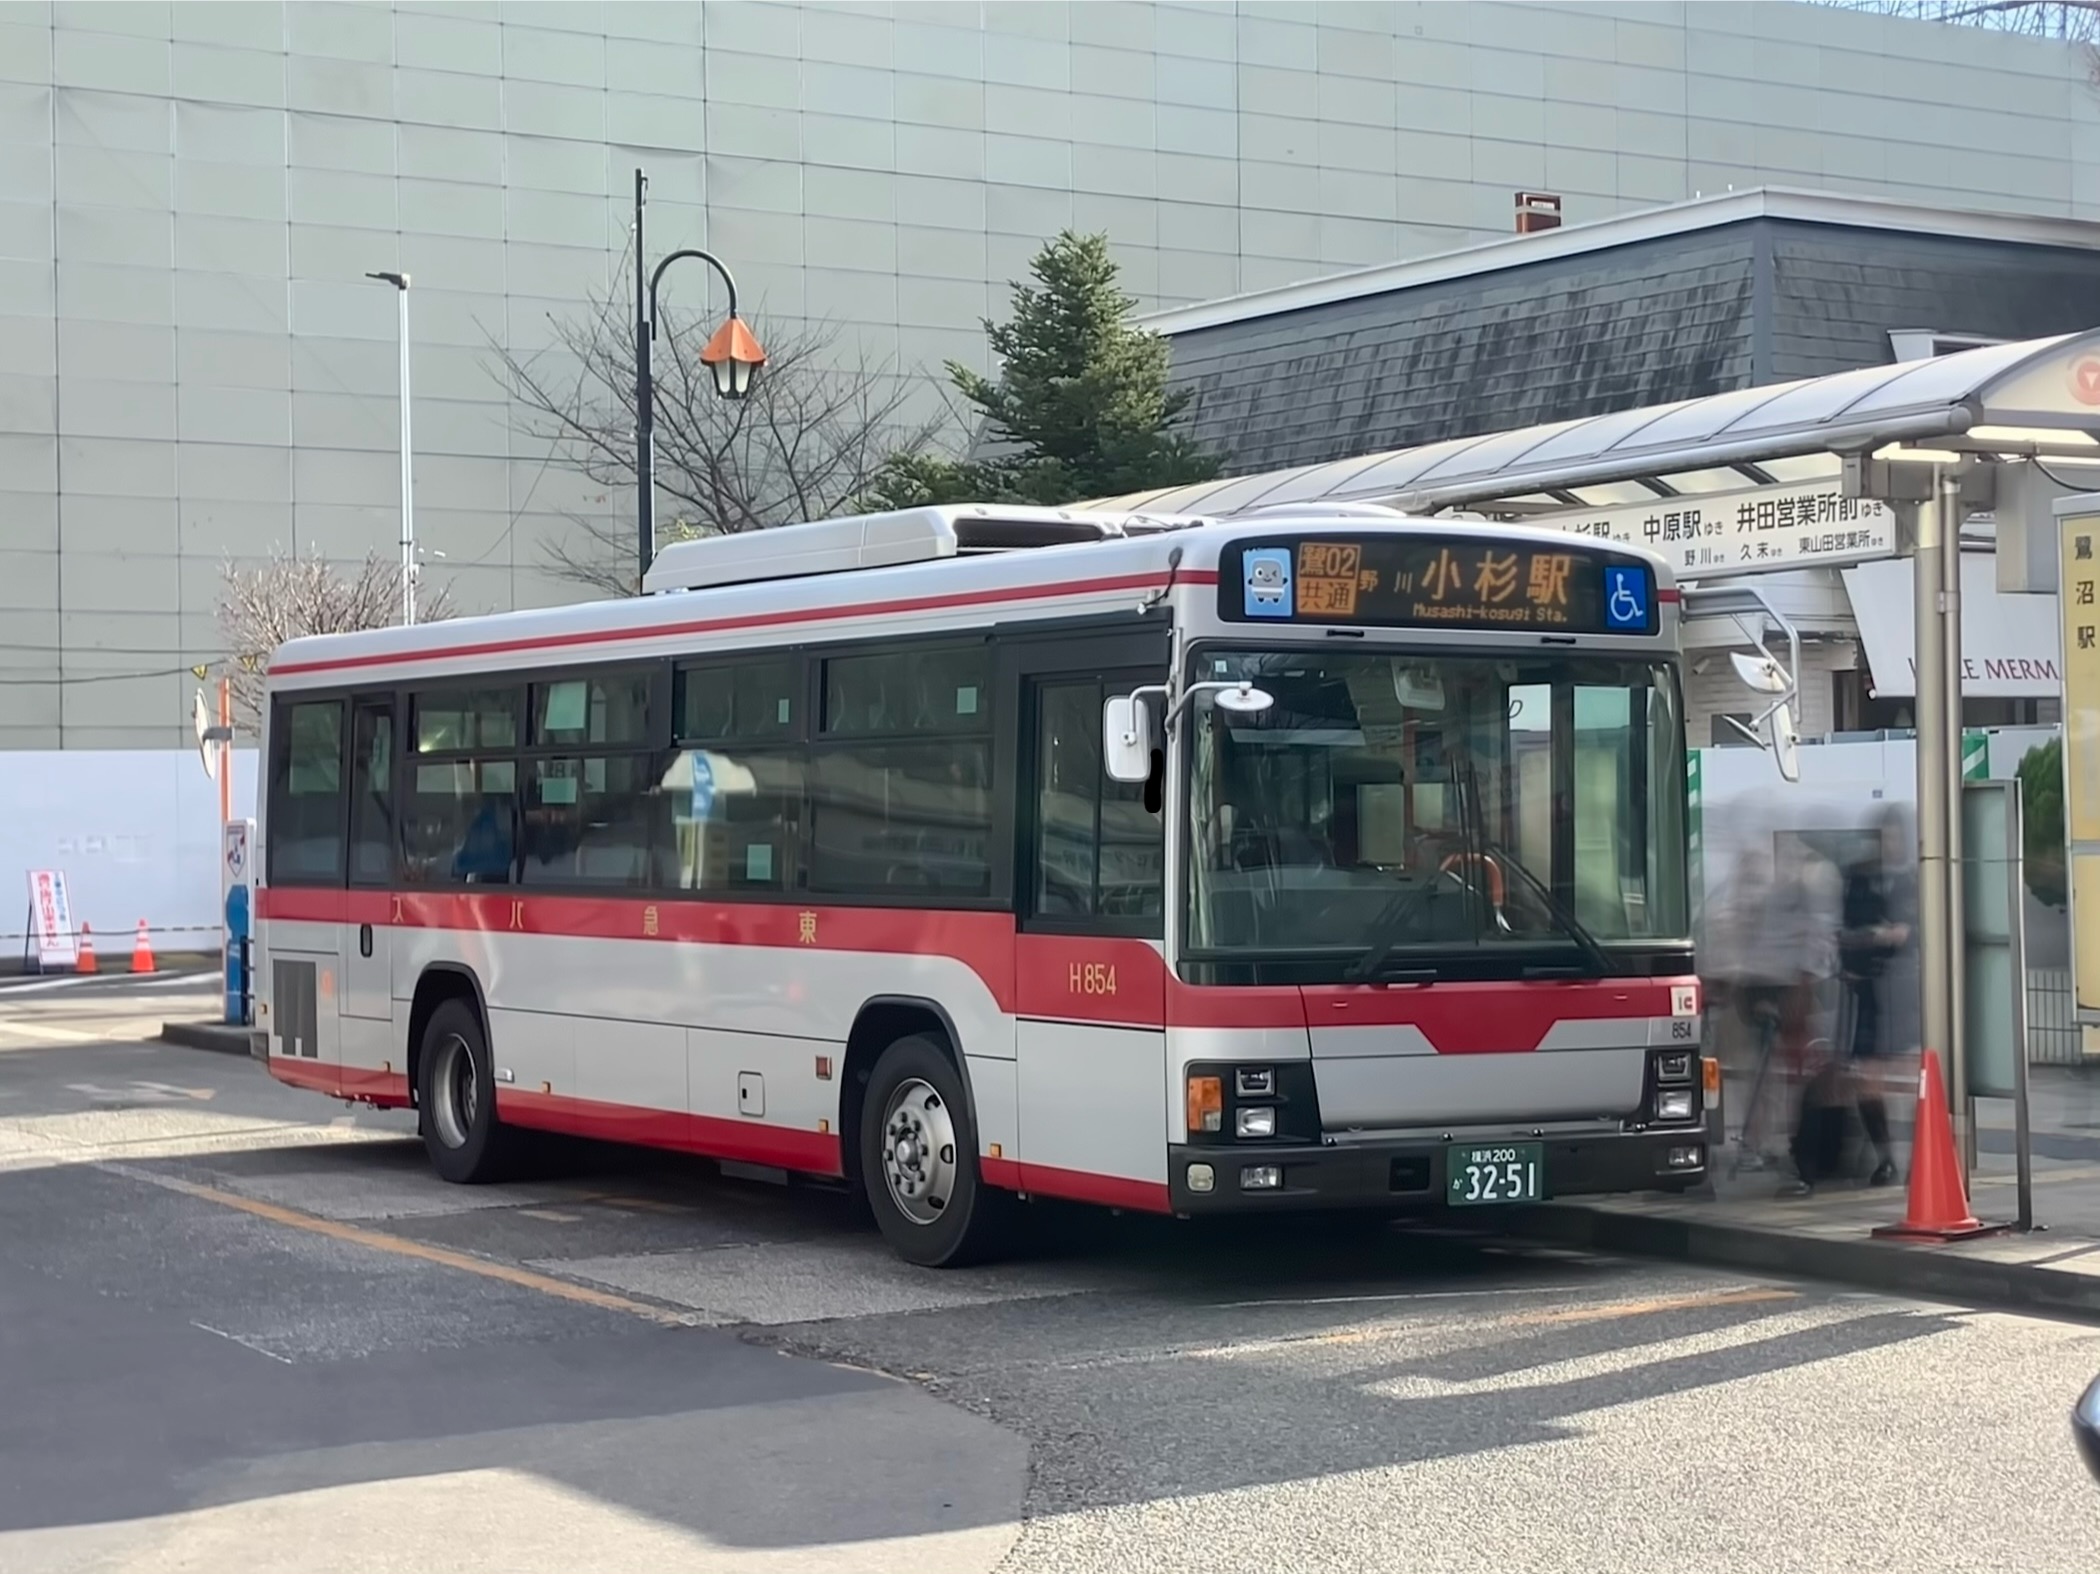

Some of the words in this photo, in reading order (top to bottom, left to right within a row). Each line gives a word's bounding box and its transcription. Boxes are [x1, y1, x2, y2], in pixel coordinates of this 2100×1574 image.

[1420, 548, 1571, 605] 小杉駅
[1300, 581, 1351, 609] 共通
[2074, 535, 2096, 650] 鷺沼駅
[1412, 602, 1530, 621] Musashi-kosugi
[1536, 607, 1568, 622] Sta.
[1984, 658, 2063, 680] MERM
[1069, 961, 1117, 996] H854
[1672, 1020, 1692, 1039] 854
[1465, 1162, 1535, 1200] 32-51
